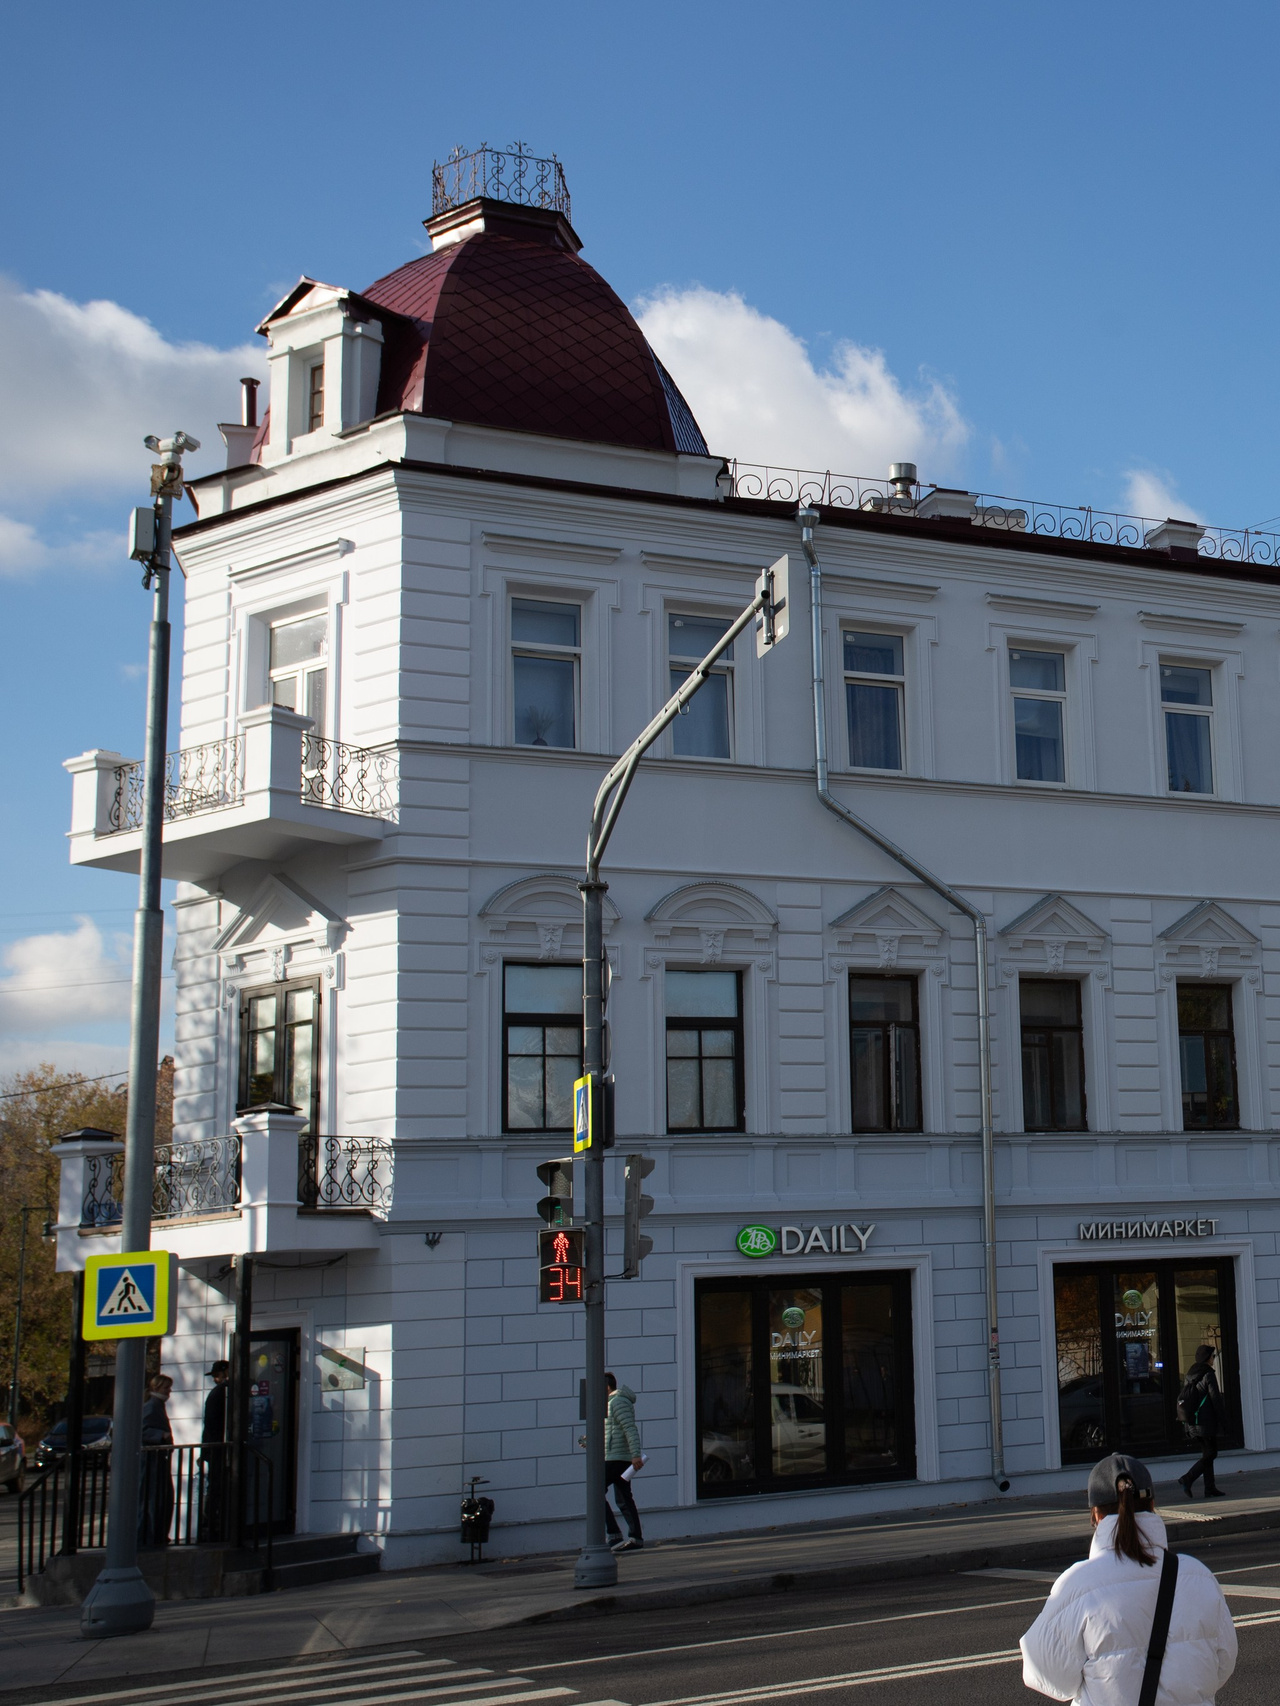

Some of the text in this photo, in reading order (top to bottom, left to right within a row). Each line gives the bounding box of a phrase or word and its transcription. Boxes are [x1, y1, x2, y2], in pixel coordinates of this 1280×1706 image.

[781, 1224, 876, 1255] DAILY
[1079, 1219, 1219, 1240] МИНИМАРКЕТ
[550, 1268, 581, 1301] 34
[1114, 1311, 1153, 1327] DAILY
[771, 1330, 817, 1348] DAILY
